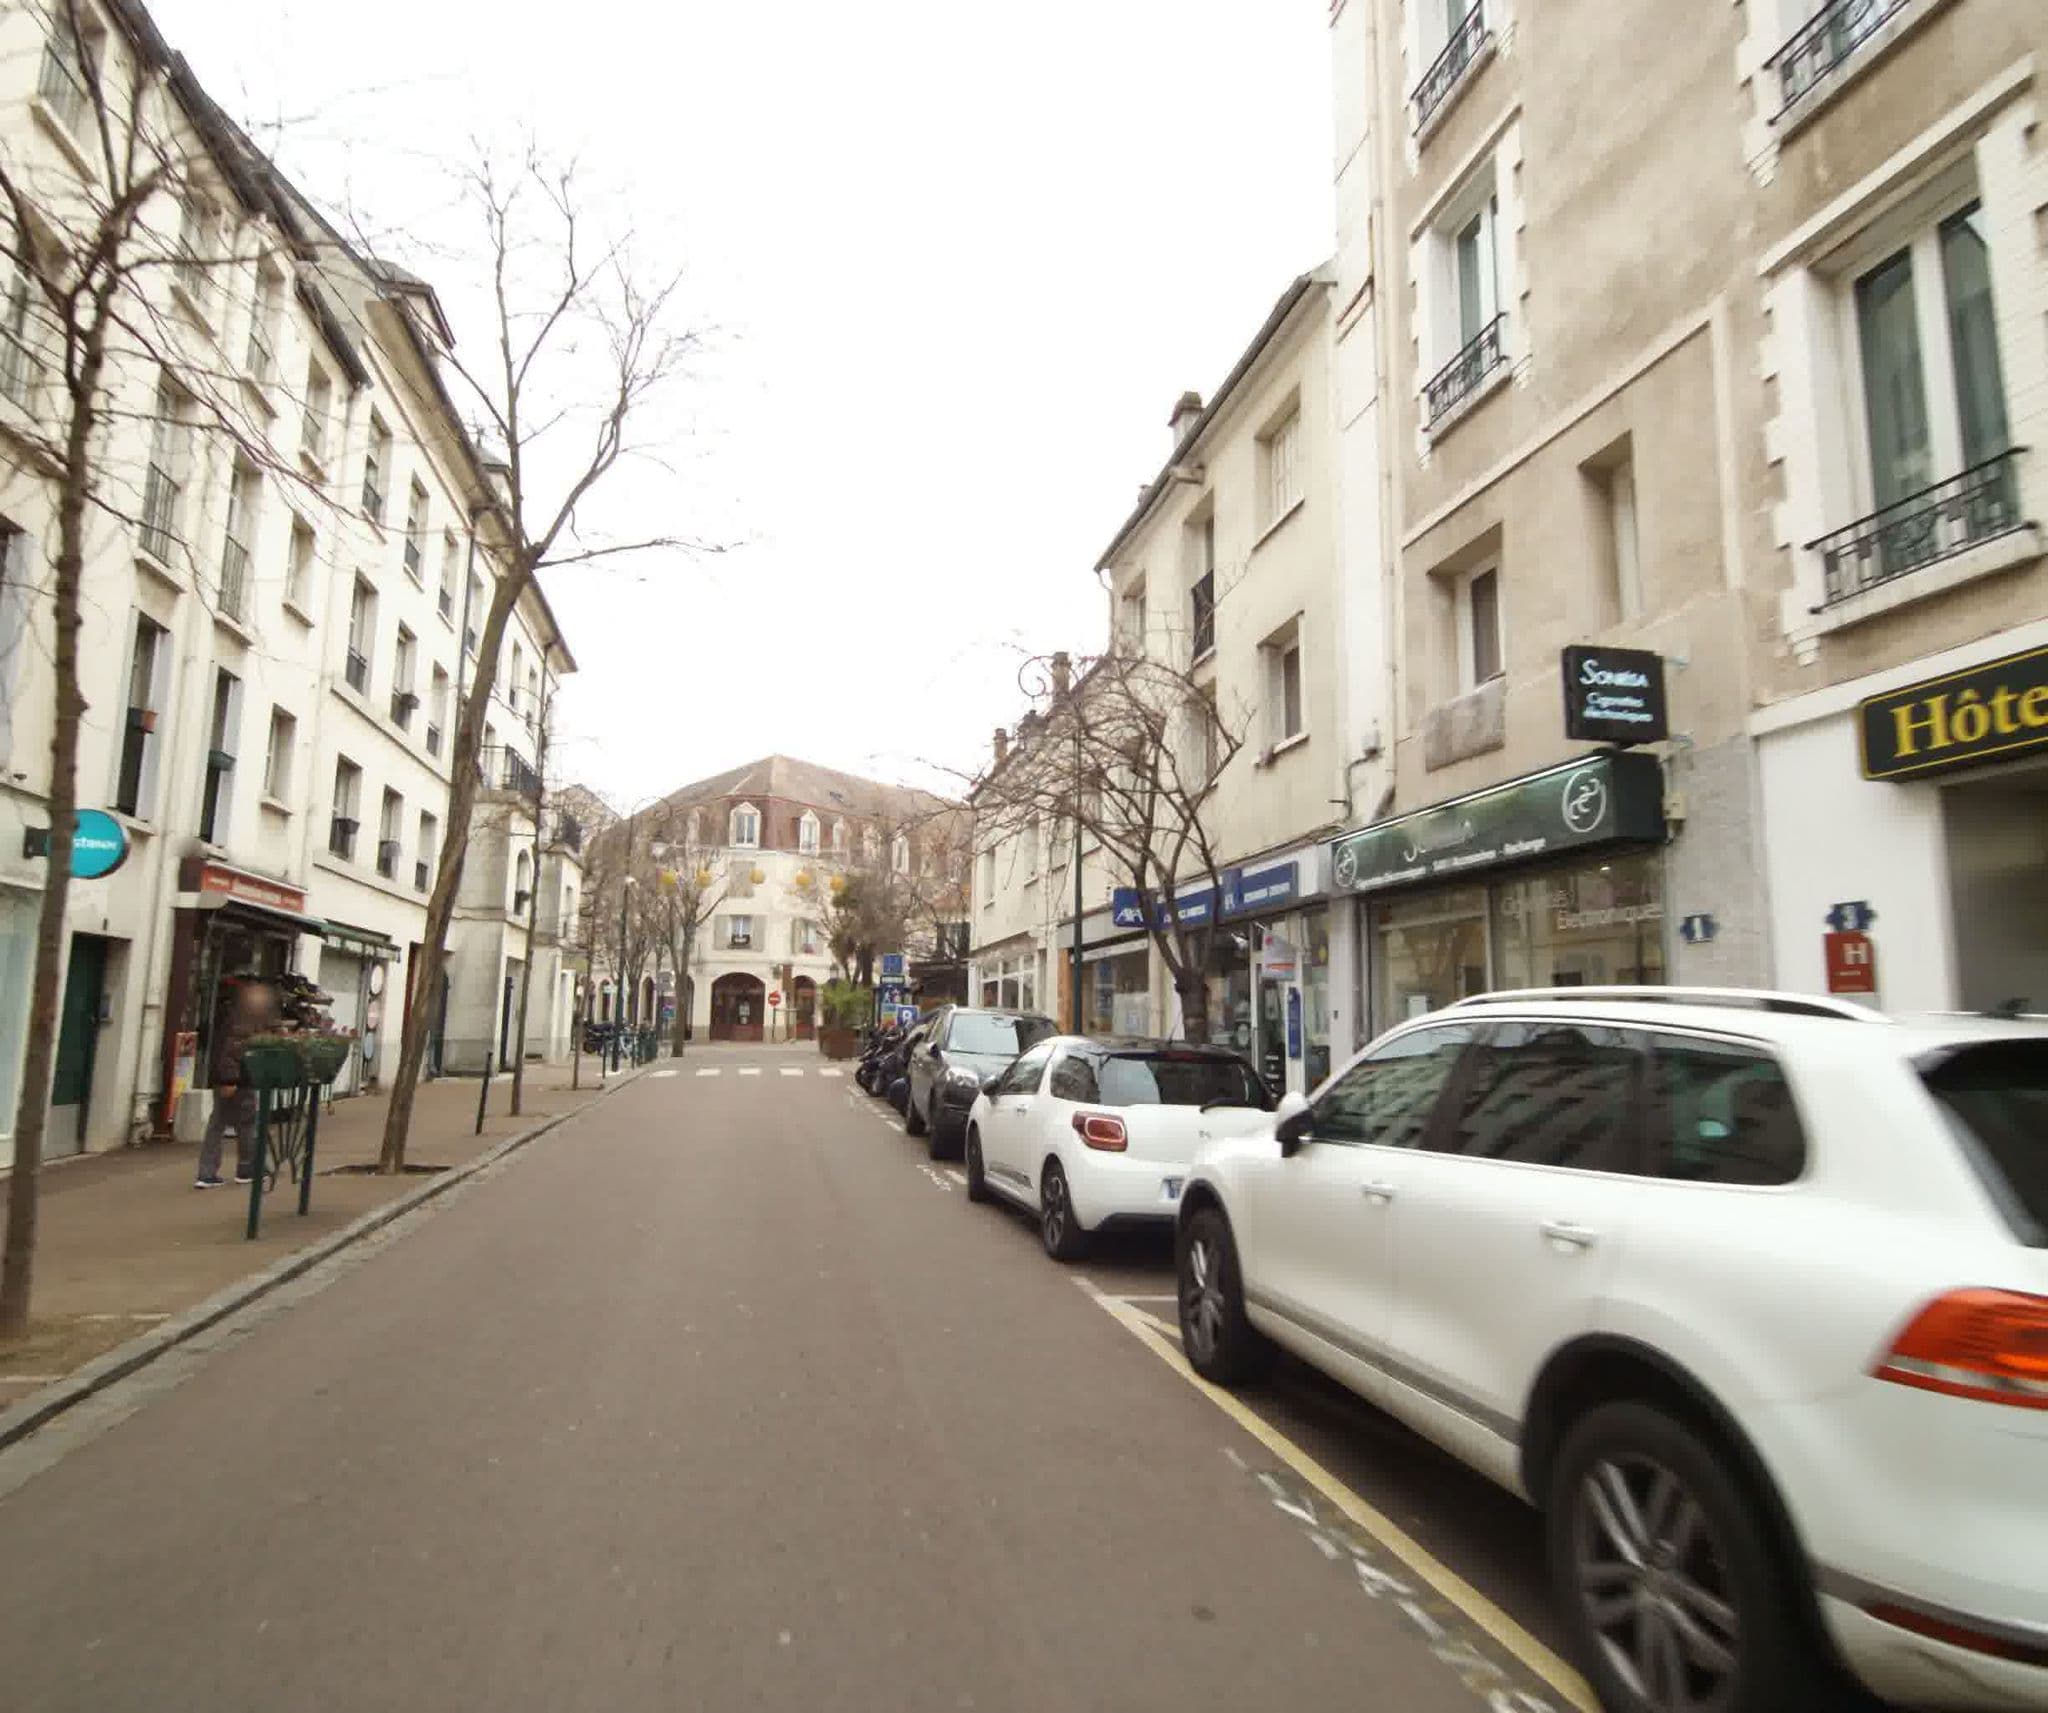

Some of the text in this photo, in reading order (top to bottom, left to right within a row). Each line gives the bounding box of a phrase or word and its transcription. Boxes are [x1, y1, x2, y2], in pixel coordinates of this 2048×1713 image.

[1889, 684, 2048, 758] Hôte
[1115, 907, 1144, 923] AXA
[1842, 942, 1869, 965] H
